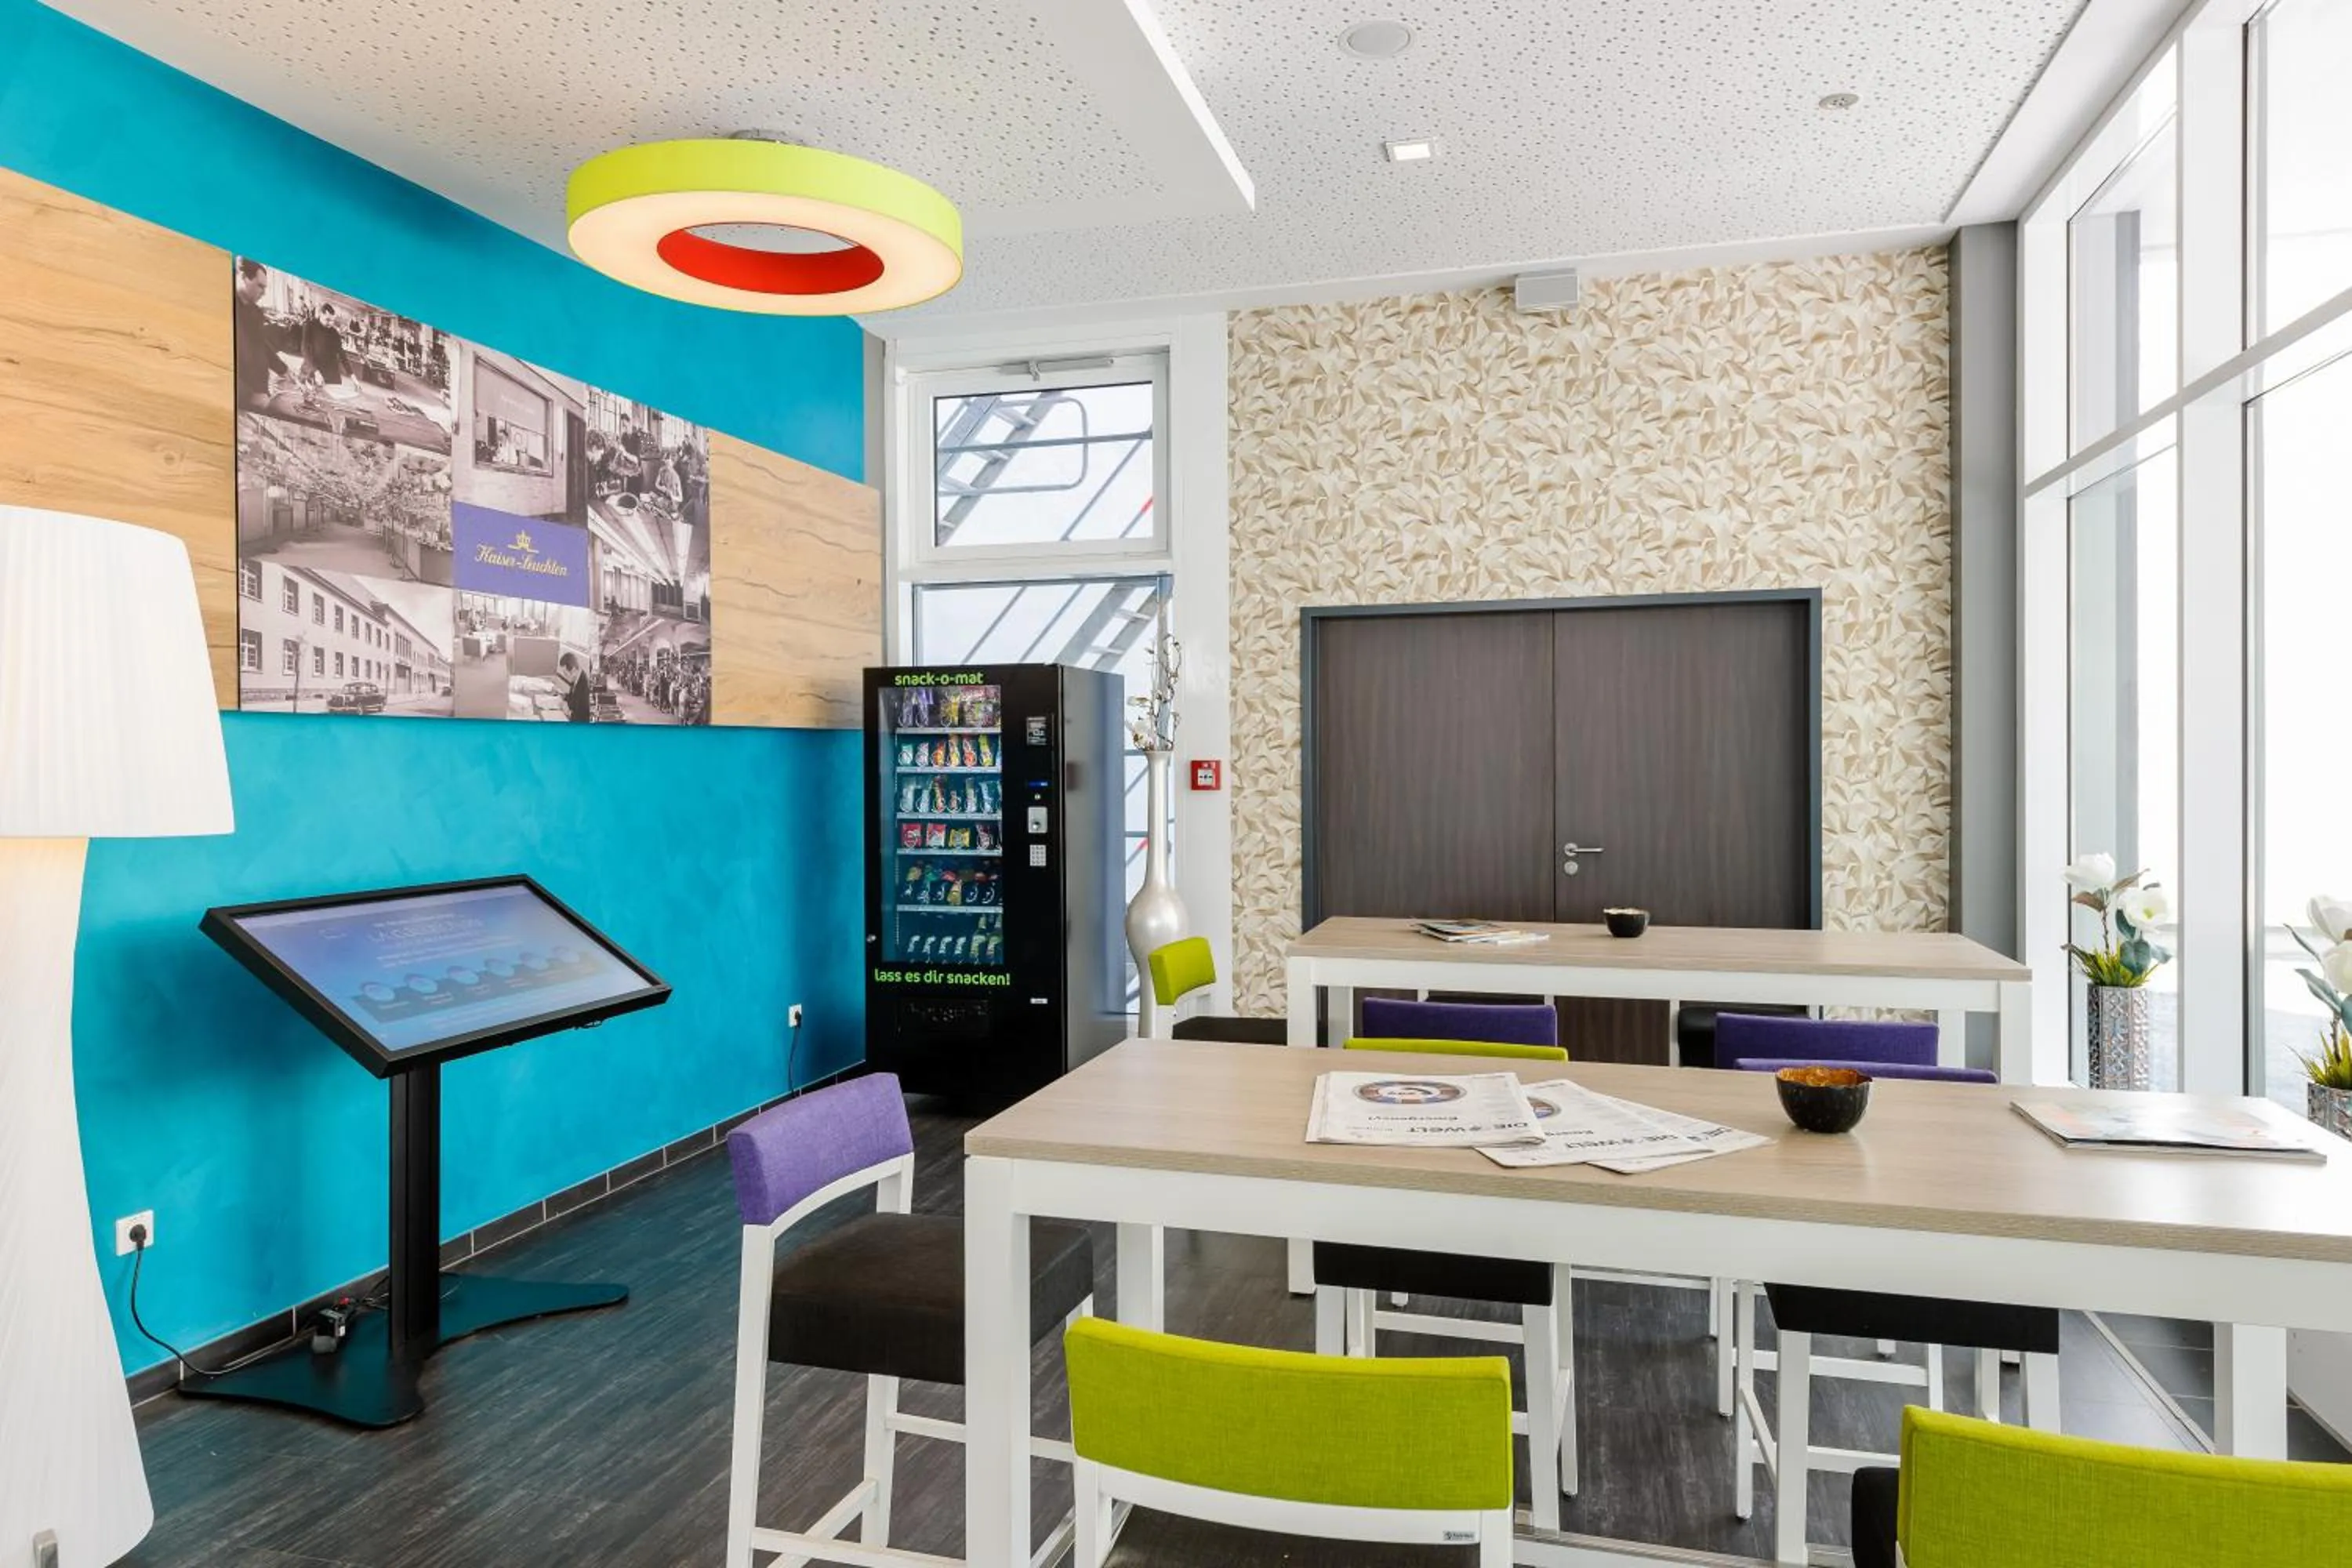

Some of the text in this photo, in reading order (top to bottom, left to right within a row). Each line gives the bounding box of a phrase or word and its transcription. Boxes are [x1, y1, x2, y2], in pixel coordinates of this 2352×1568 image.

[895, 672, 984, 686] snack-o-mat
[874, 968, 1011, 985] lass es dir snacken!
